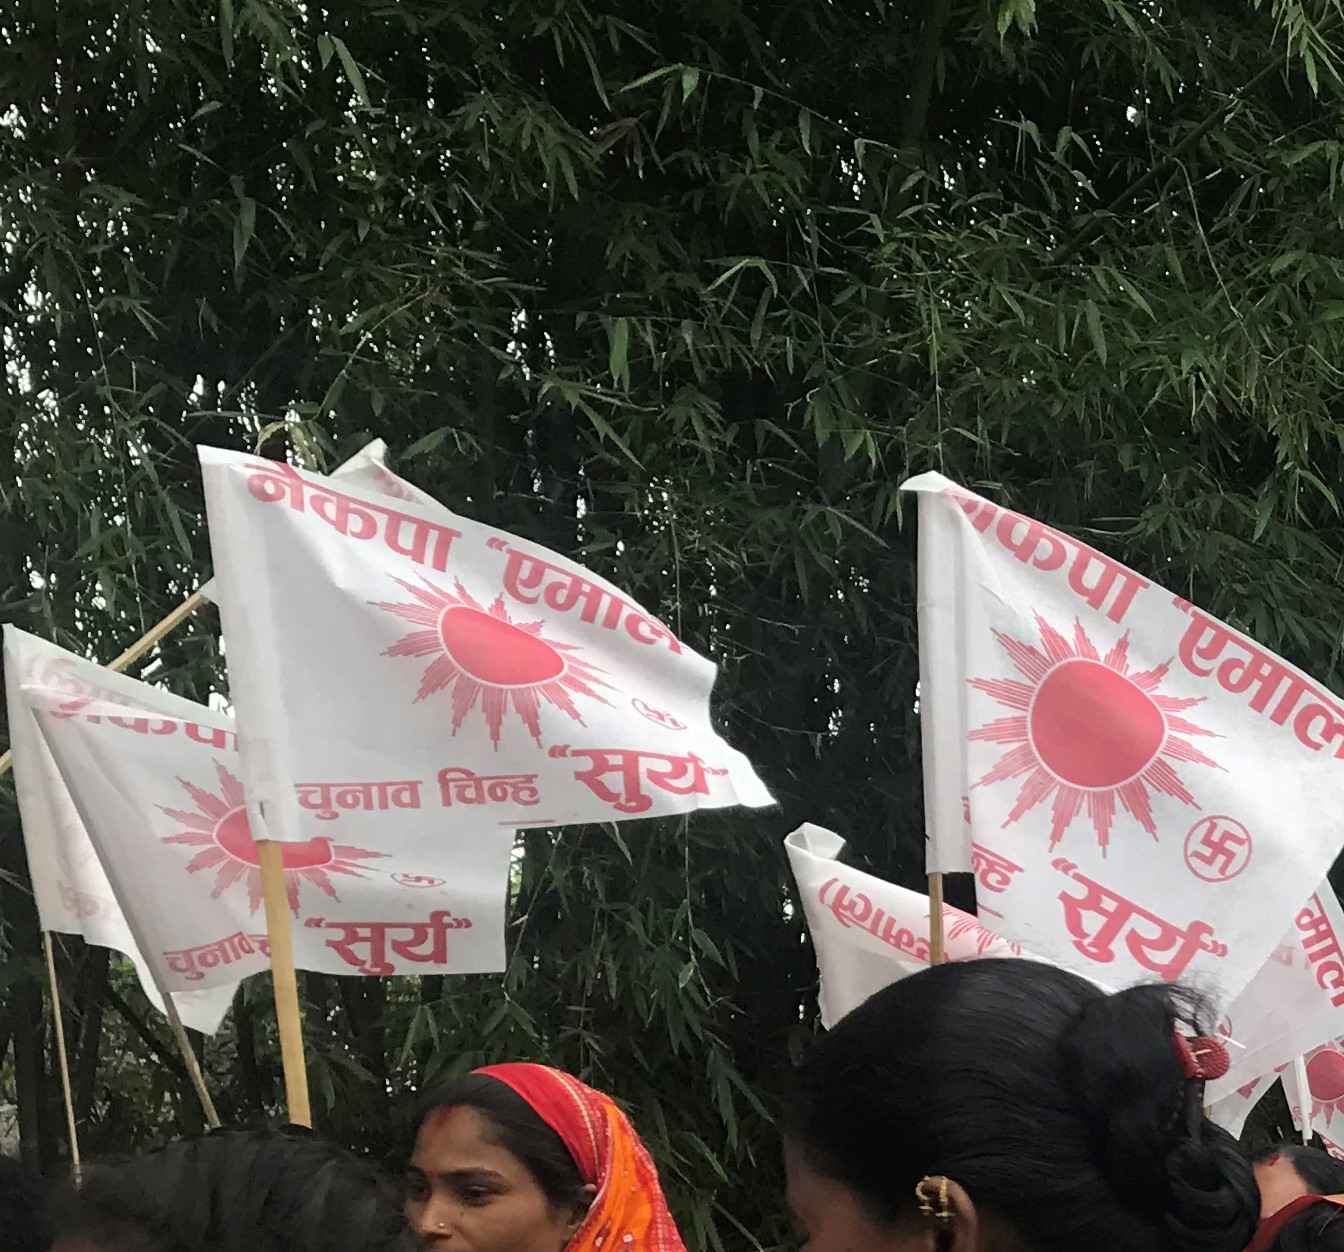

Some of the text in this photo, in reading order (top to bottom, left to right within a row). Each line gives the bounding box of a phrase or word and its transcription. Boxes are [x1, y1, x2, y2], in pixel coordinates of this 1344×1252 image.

[244, 461, 463, 573] नेकपा
[294, 779, 423, 821] चुनाव
[437, 767, 541, 807] चिन्ह
